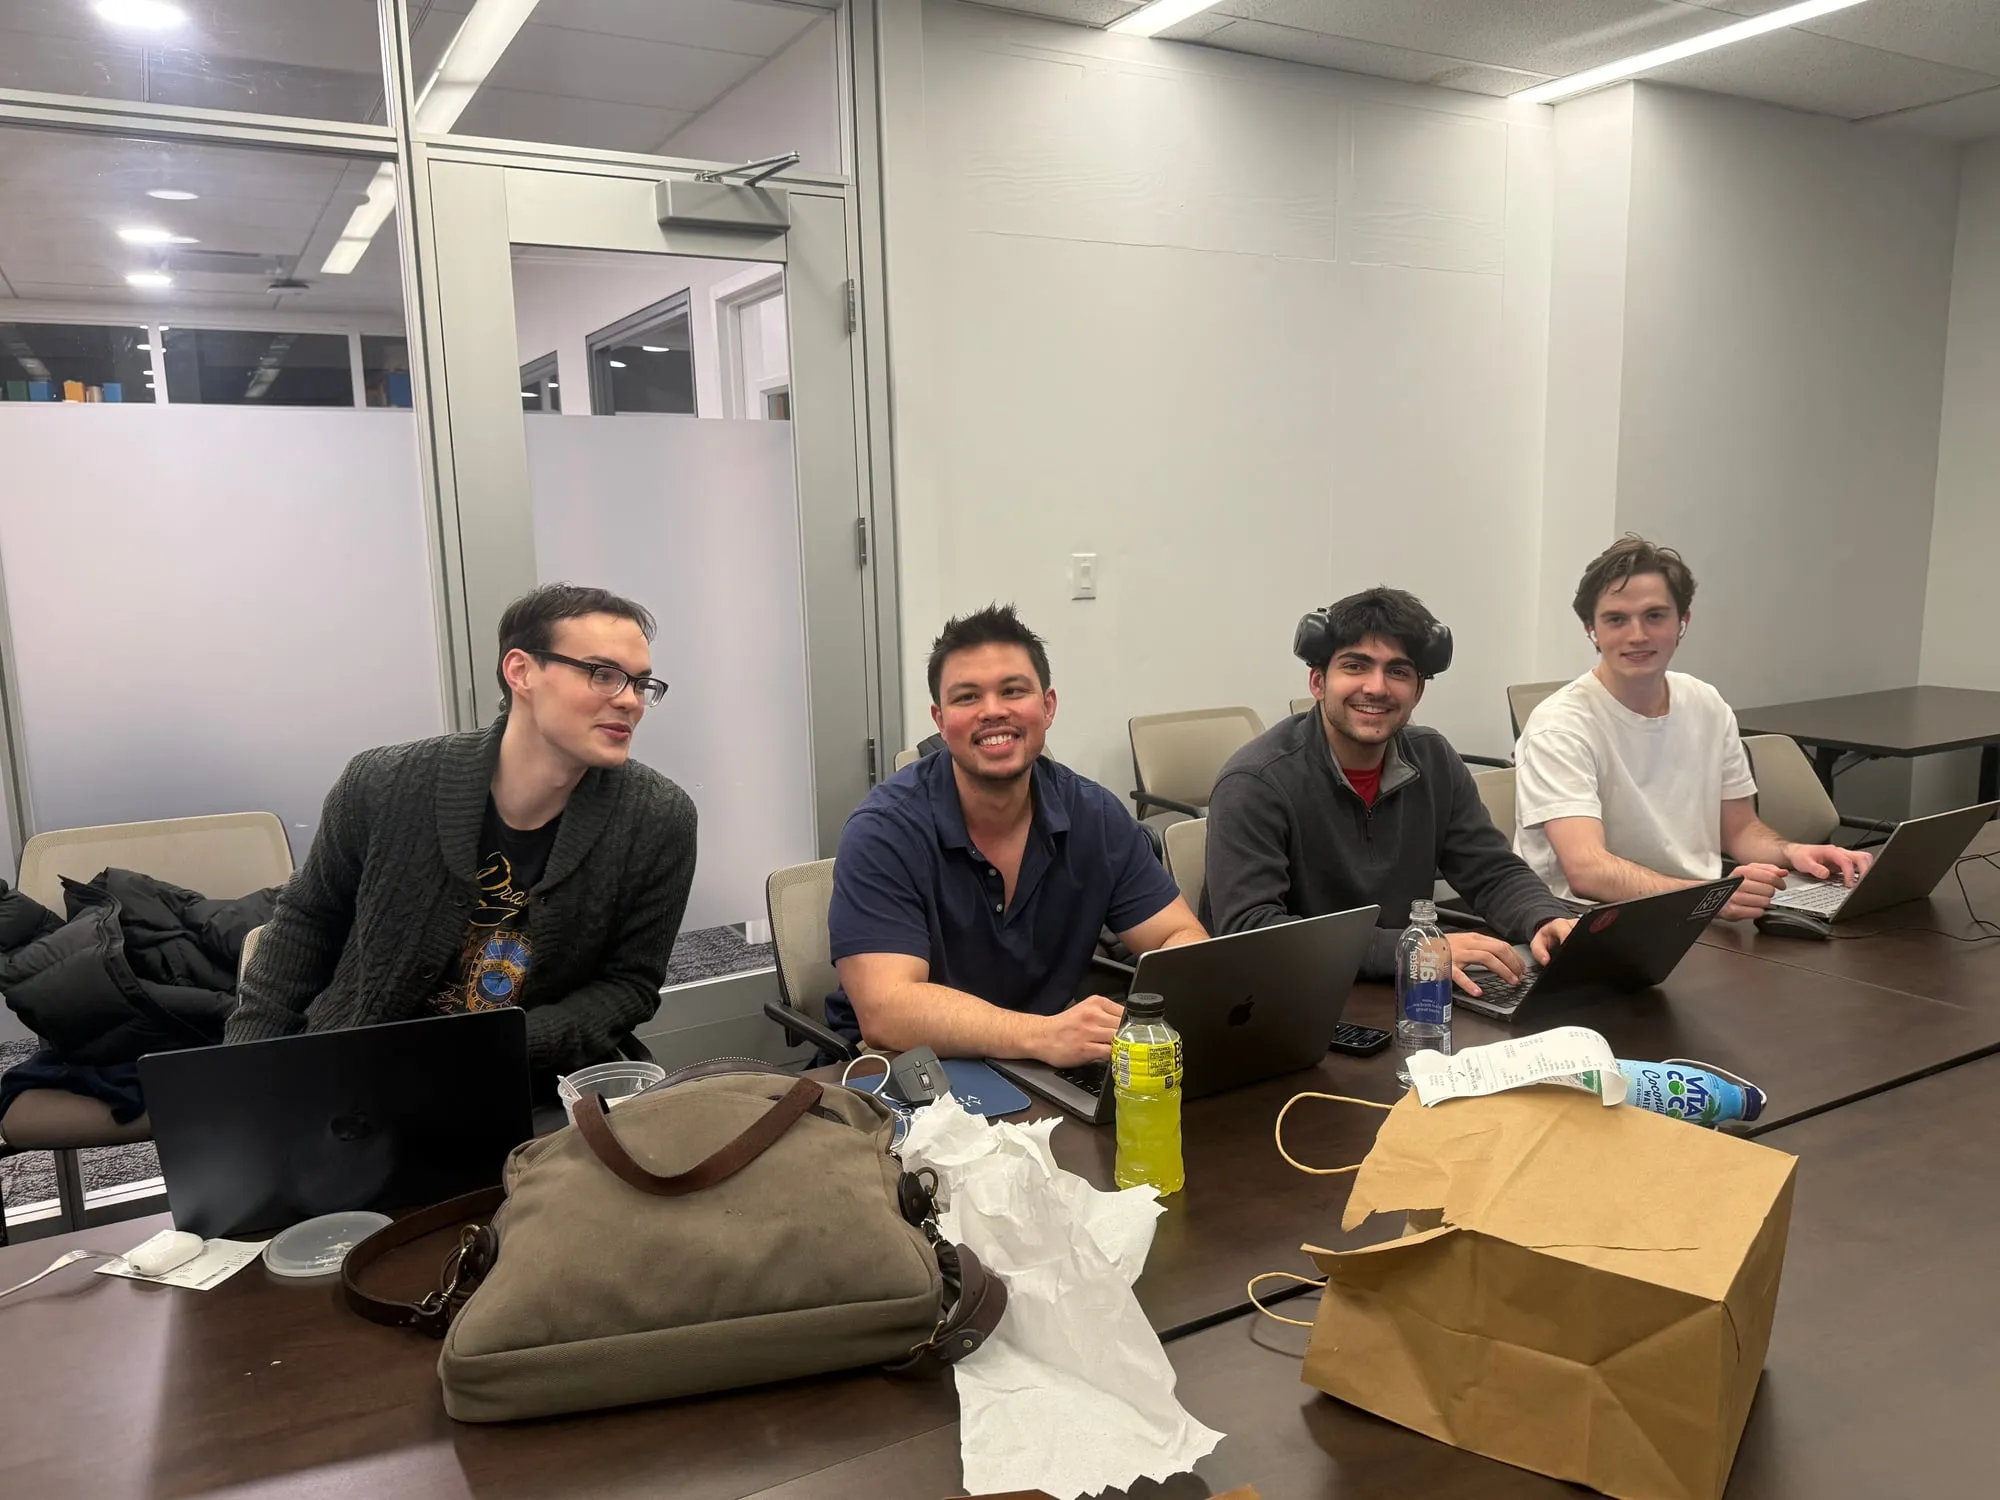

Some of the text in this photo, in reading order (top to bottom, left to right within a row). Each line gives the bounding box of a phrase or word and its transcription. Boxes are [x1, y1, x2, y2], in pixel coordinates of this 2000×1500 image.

[1642, 1069, 1667, 1115] Coconu
[1643, 1090, 1652, 1111] WATE
[1667, 1070, 1685, 1120] COCO
[1685, 1077, 1709, 1117] VITA
